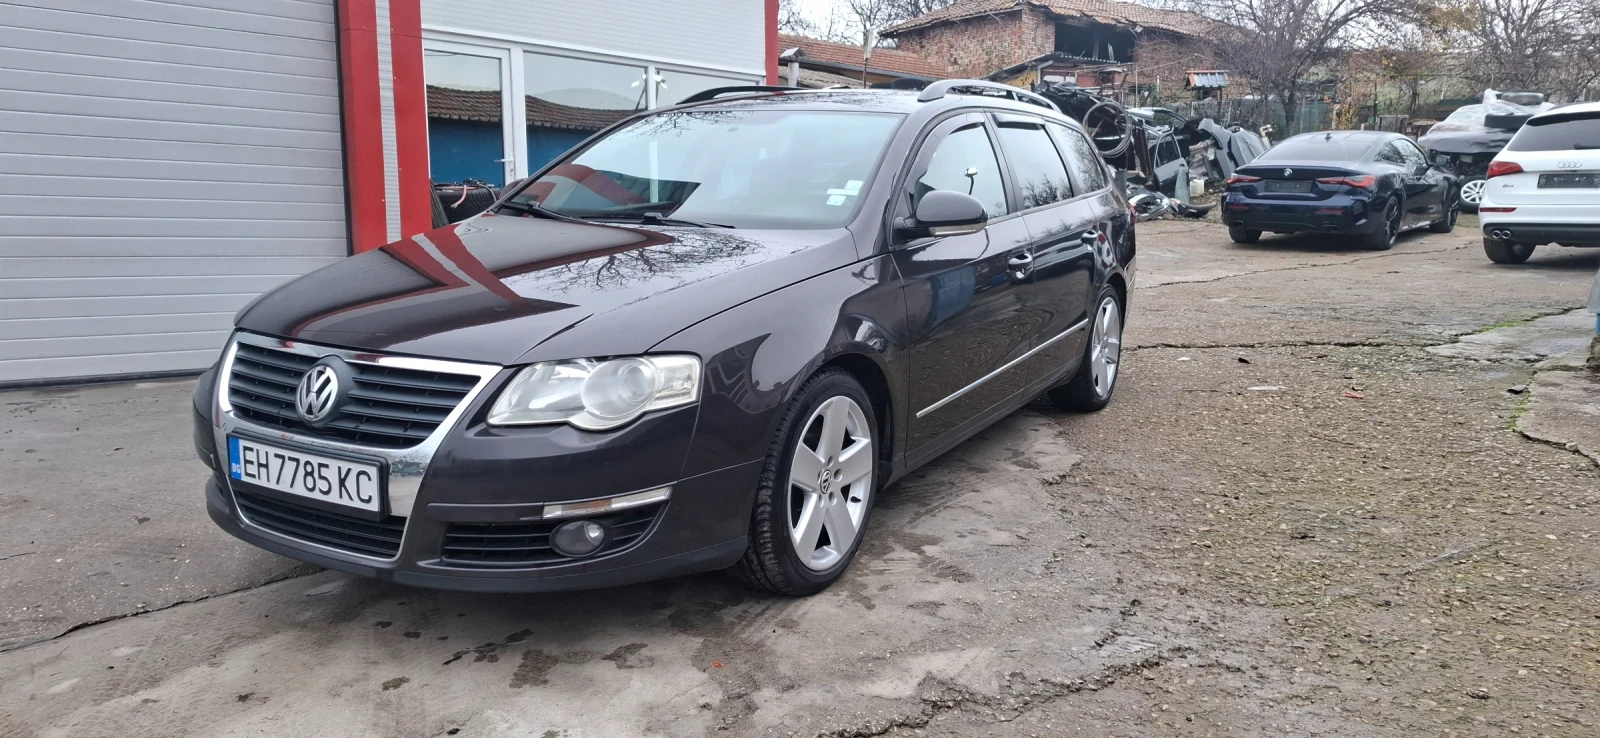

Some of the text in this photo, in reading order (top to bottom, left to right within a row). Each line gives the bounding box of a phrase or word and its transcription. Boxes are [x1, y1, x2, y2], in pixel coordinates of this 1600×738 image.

[298, 365, 339, 422] VW
[232, 463, 241, 474] BG
[243, 446, 373, 504] EH 7785 KC
